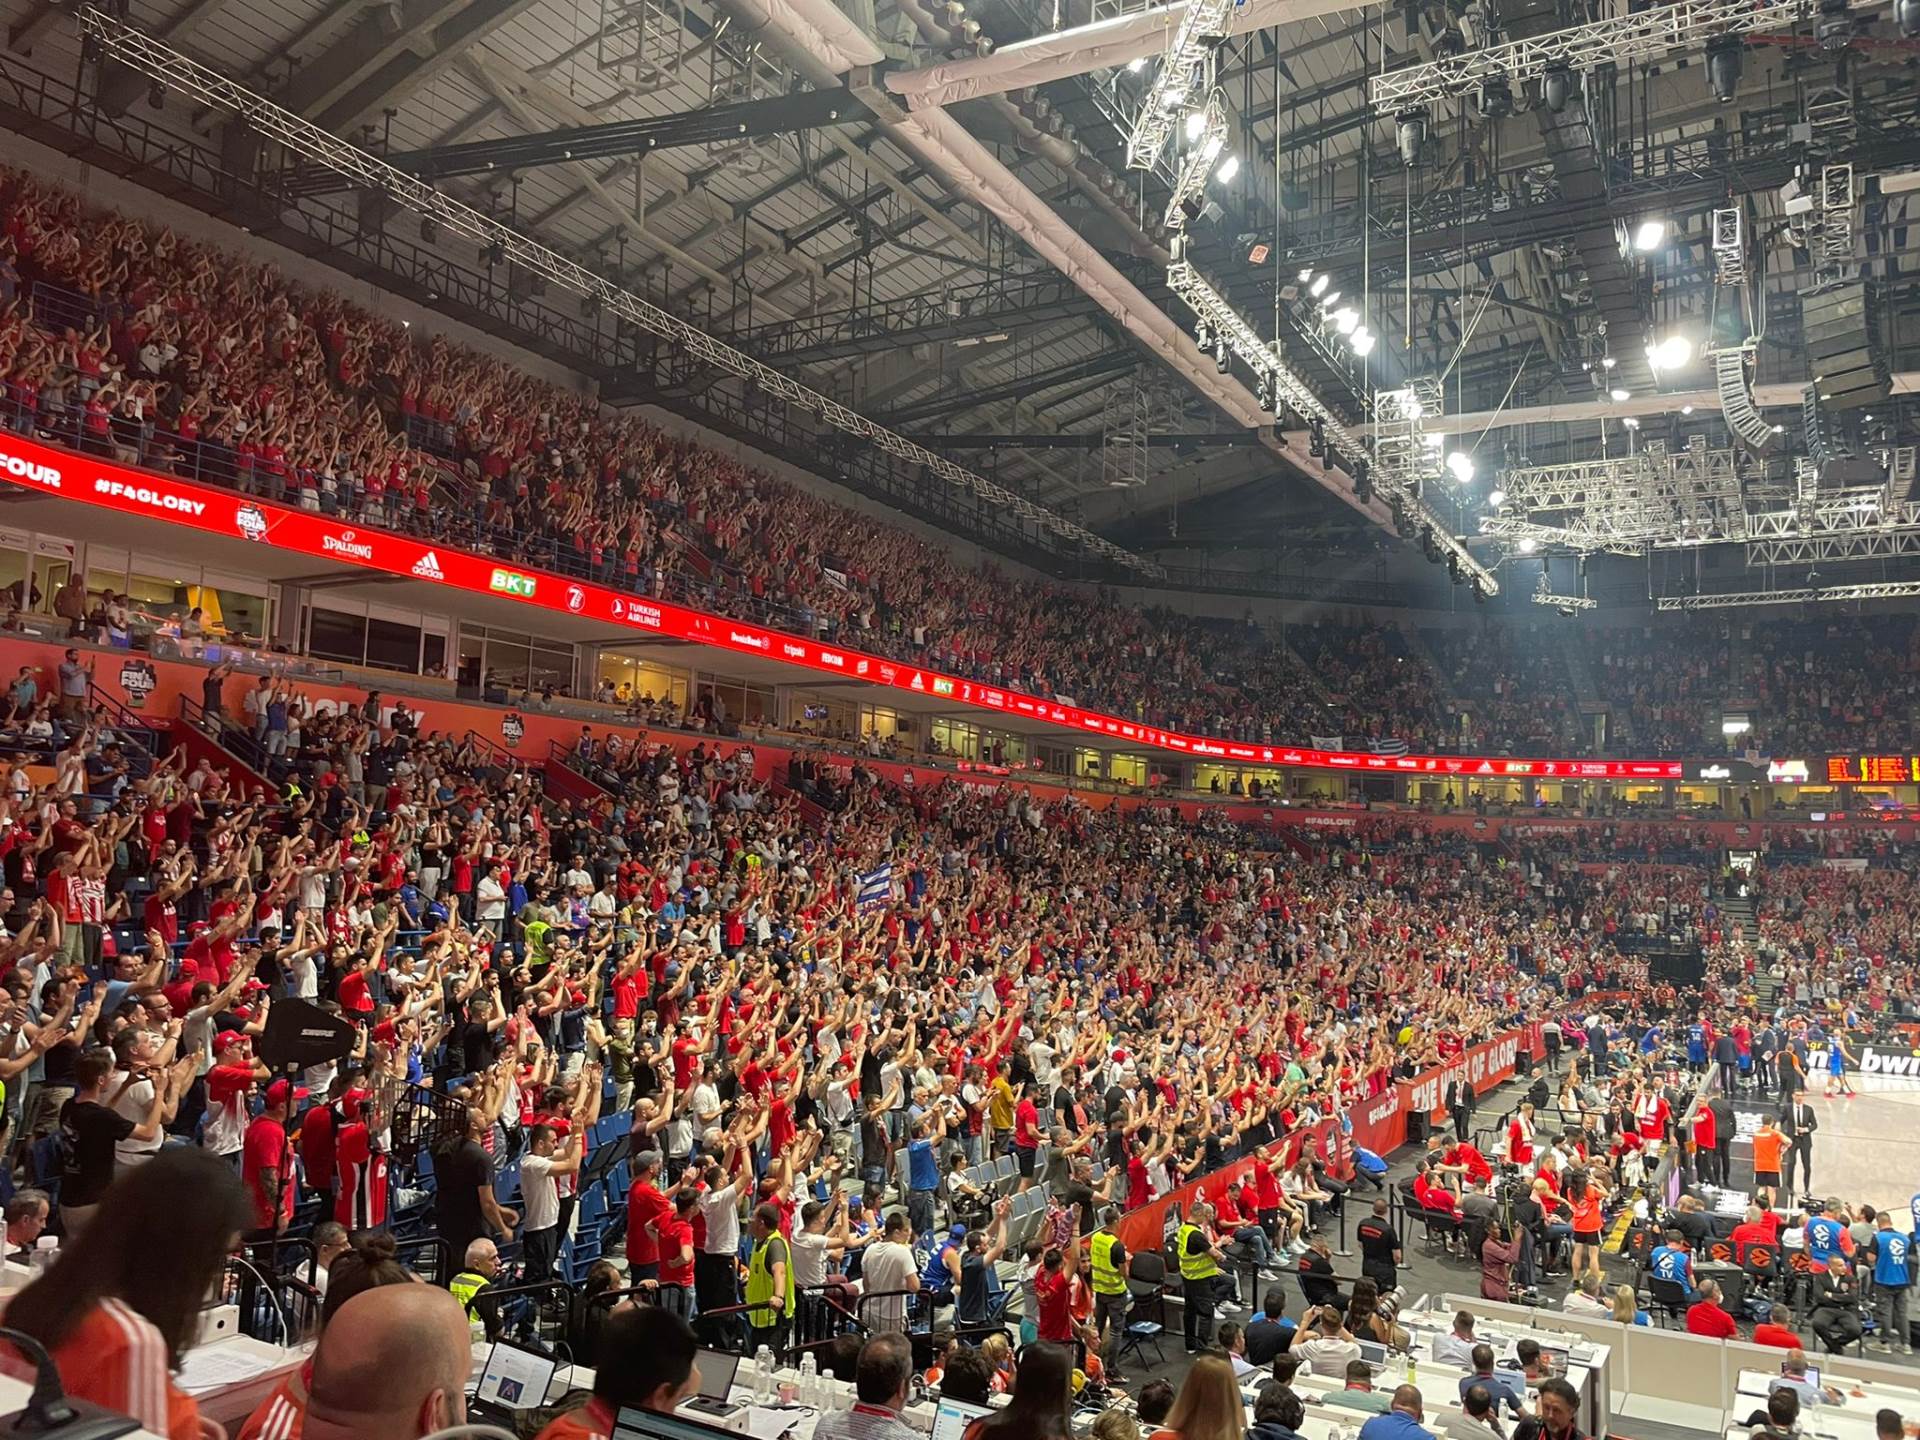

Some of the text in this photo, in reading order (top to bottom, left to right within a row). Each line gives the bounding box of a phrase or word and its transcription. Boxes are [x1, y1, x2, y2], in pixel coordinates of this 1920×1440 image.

[322, 535, 372, 559] SPALDING
[412, 565, 444, 580] adidas
[491, 571, 536, 594] BKT
[629, 602, 660, 617] TURKISH
[627, 612, 660, 627] AIRLINES
[933, 679, 953, 693] BKT
[1411, 1077, 1437, 1110] THE
[1471, 1051, 1485, 1083] OF
[1489, 1037, 1518, 1075] GLORY
[1816, 1240, 1829, 1249] TV
[1660, 1268, 1673, 1278] TV
